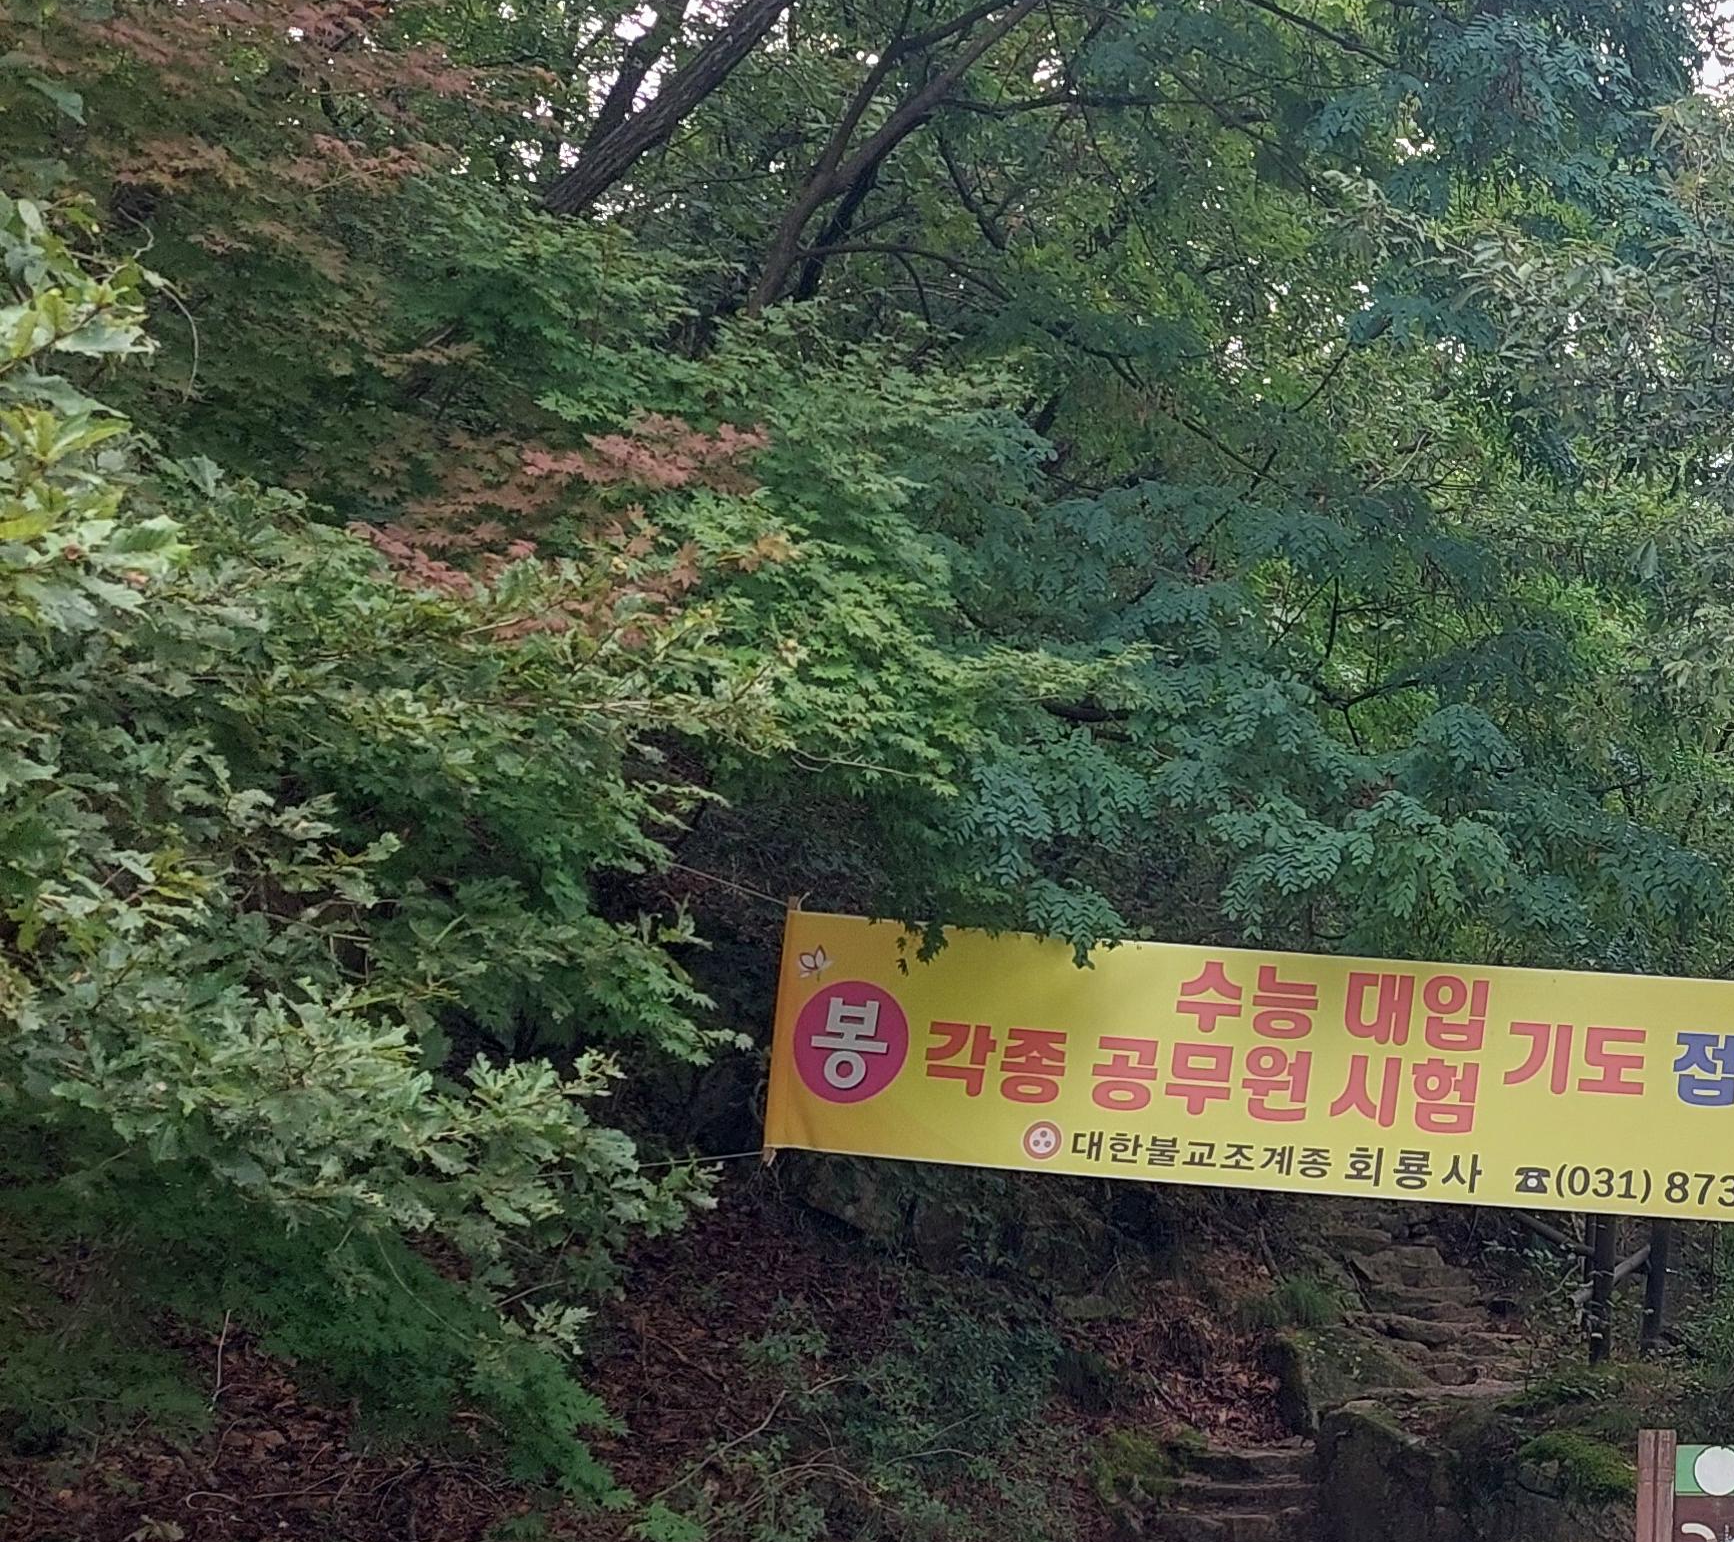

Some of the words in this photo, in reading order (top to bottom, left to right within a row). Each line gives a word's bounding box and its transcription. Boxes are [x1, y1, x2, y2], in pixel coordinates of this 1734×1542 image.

[811, 997, 888, 1090] 봉
[1176, 961, 1319, 1039] 수능
[1344, 972, 1490, 1051] 대입
[925, 1021, 1067, 1104] 각종
[1091, 1035, 1312, 1122] 공무원
[1329, 1054, 1480, 1134] 시험
[1503, 1021, 1646, 1096] 기도
[1071, 1130, 1332, 1179] 대한불교조계종
[1344, 1145, 1482, 1194] 회룡사
